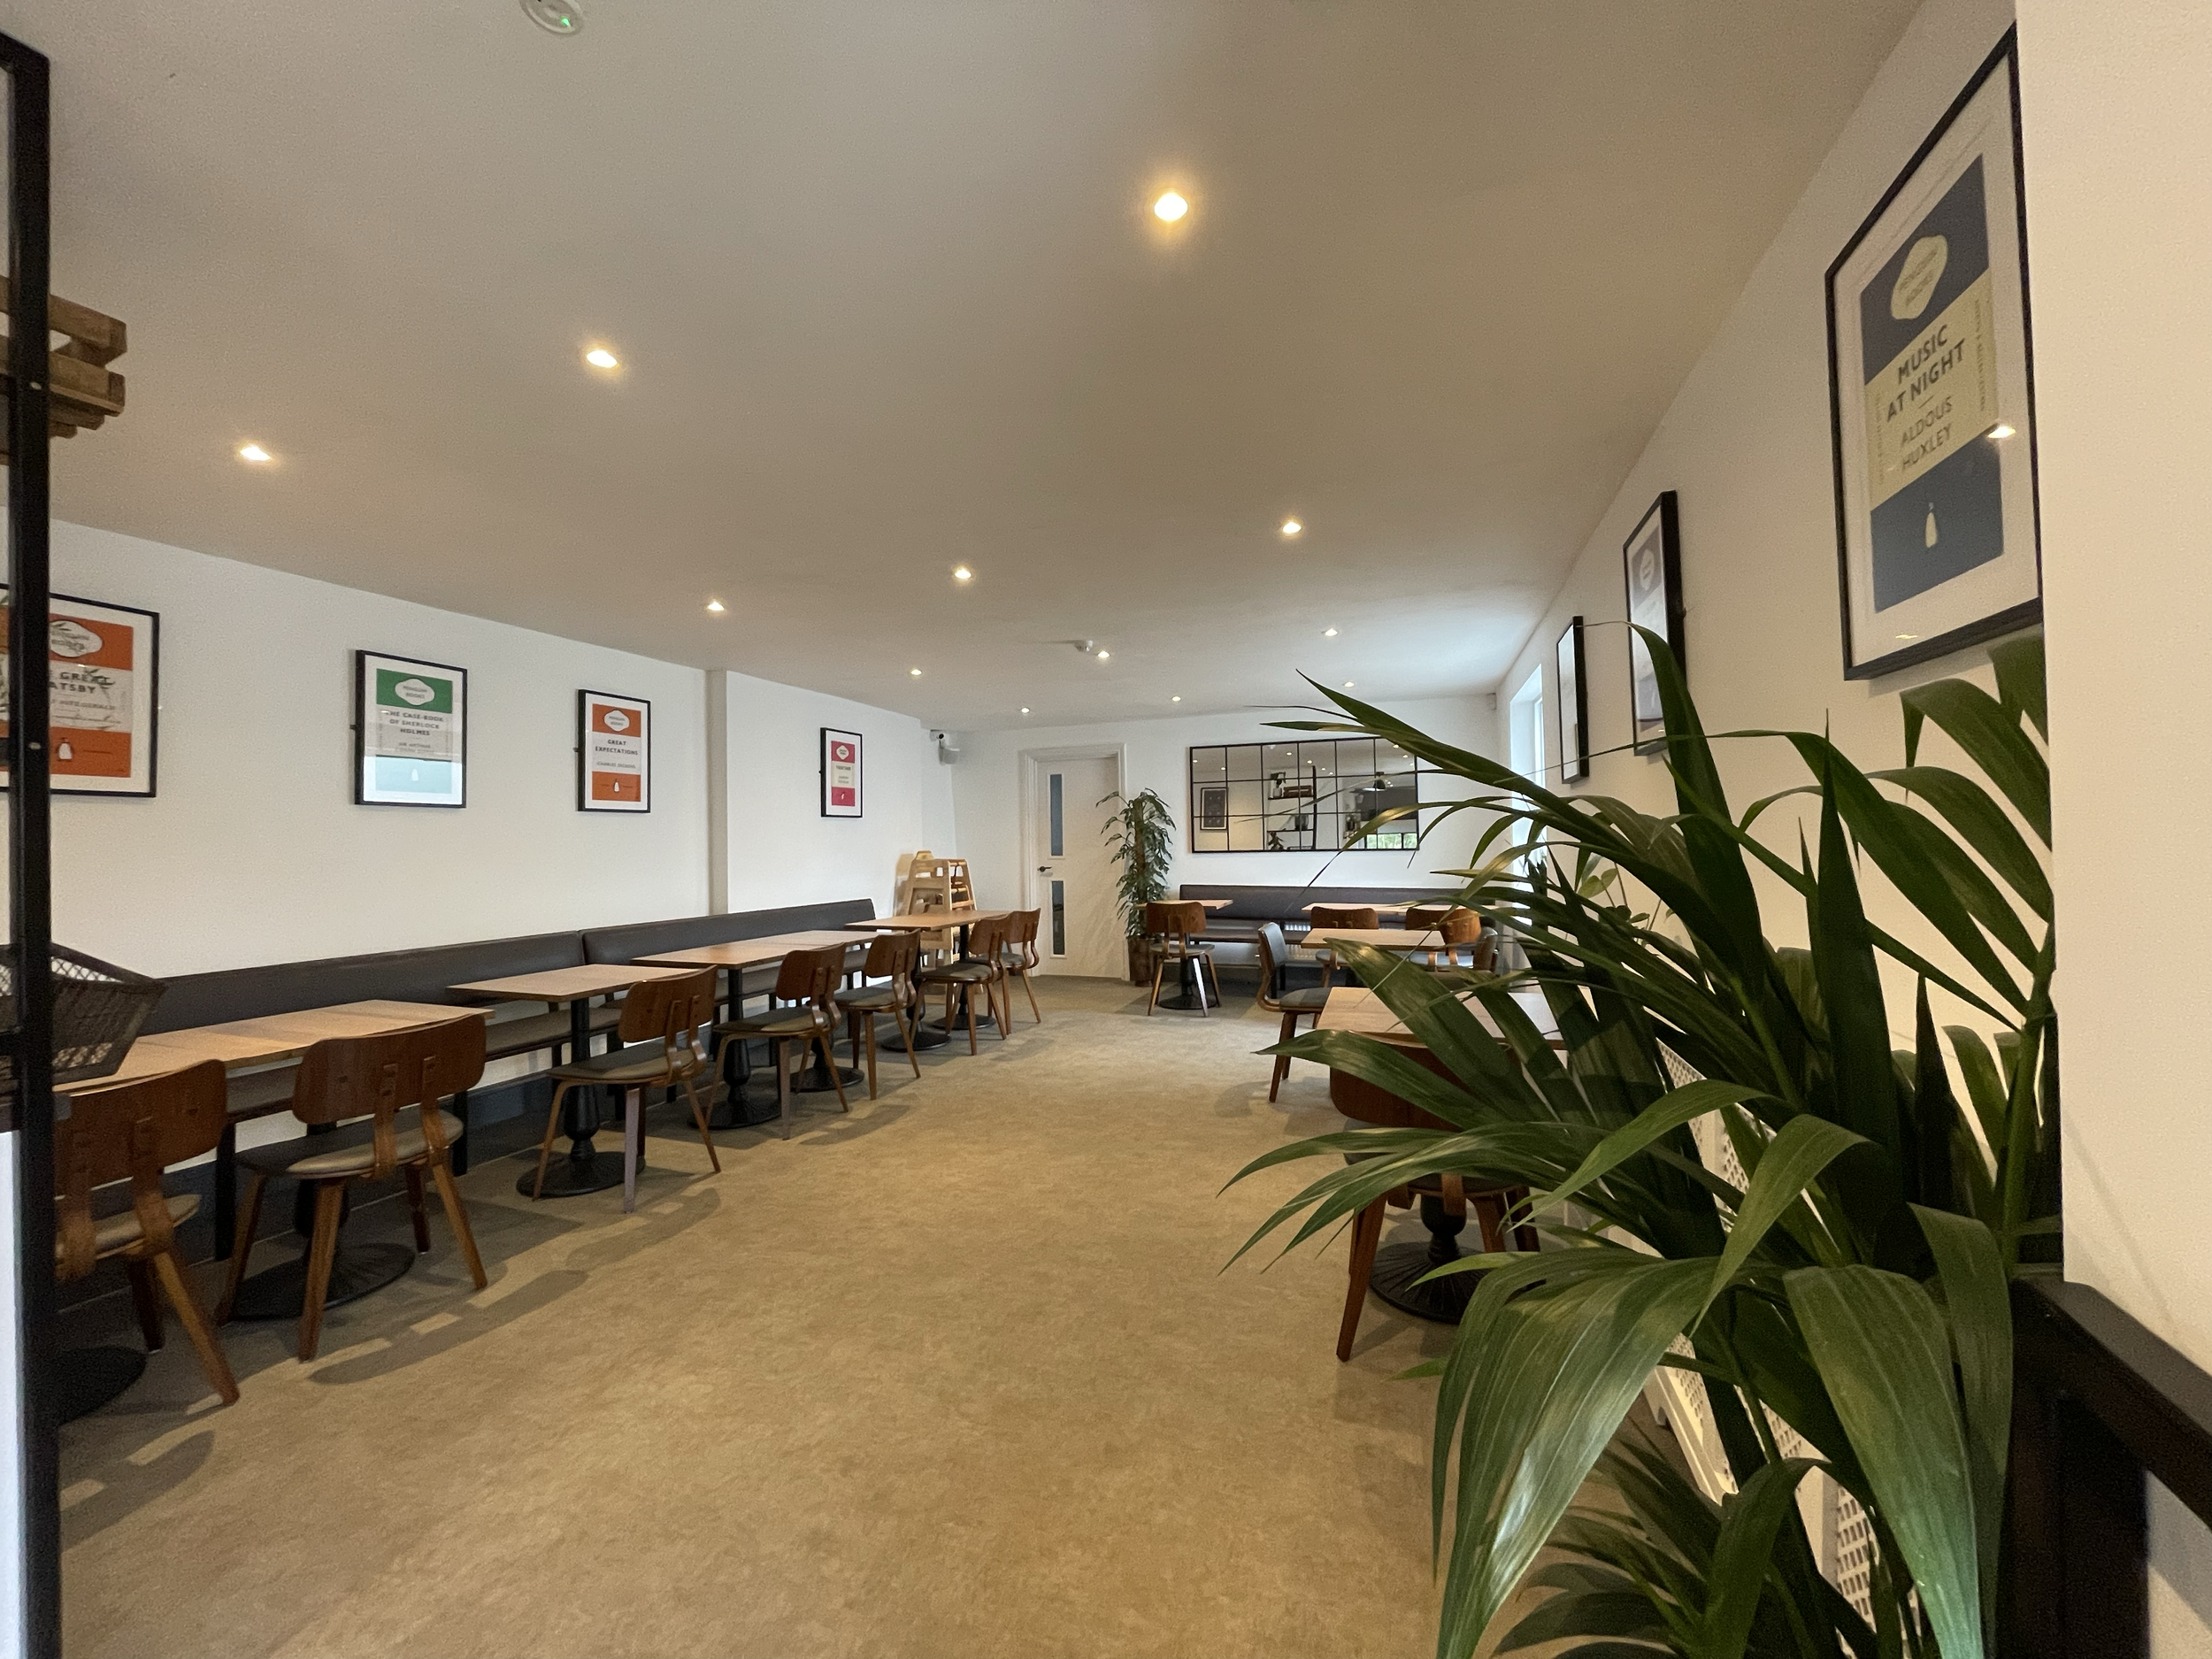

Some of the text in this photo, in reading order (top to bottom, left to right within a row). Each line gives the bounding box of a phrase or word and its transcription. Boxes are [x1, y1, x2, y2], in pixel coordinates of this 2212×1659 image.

[1898, 324, 1948, 384] MUSIC
[1887, 390, 1906, 422] AT
[1910, 338, 1965, 401] NIGHT
[1902, 396, 1953, 445] ALDOUS
[1903, 423, 1952, 470] HUXLEY
[49, 681, 96, 694] ATSBY
[402, 720, 440, 729] SHERLOCK
[595, 746, 638, 756] EXPECTATIONS
